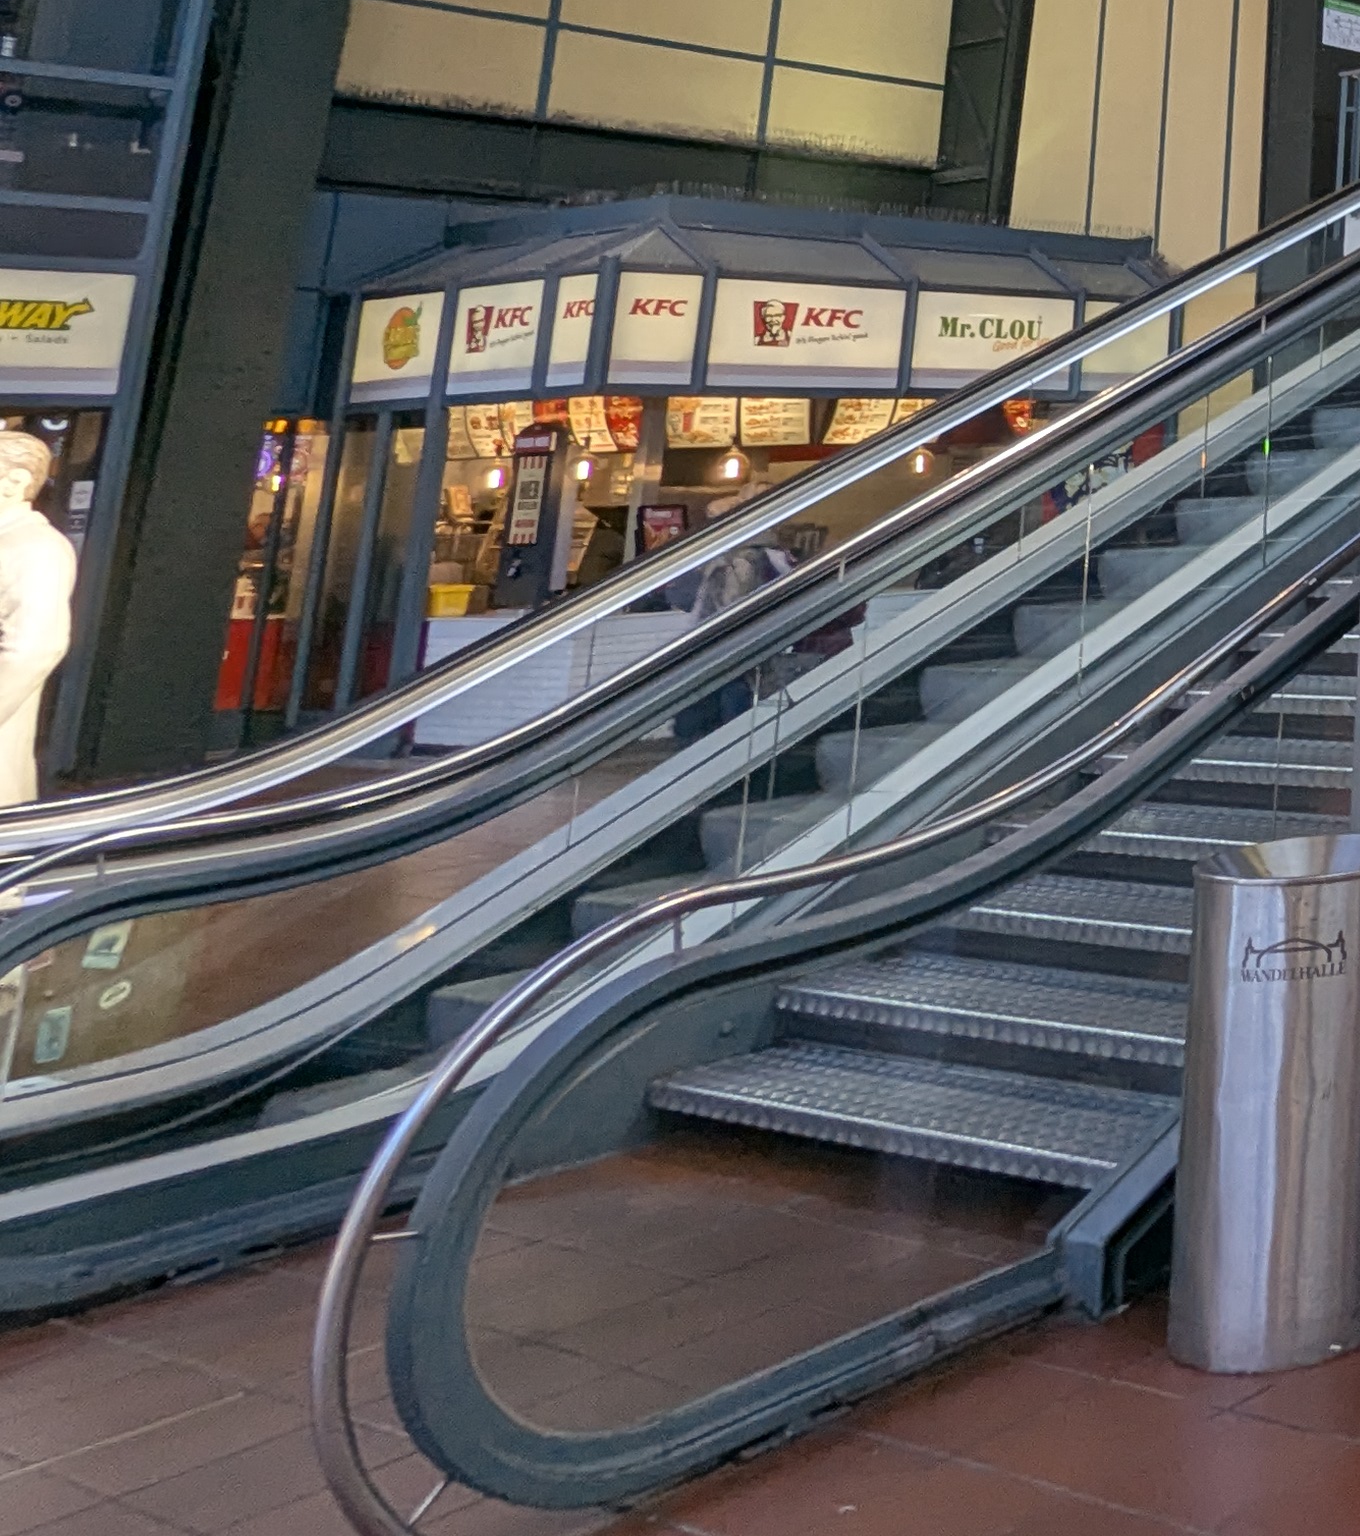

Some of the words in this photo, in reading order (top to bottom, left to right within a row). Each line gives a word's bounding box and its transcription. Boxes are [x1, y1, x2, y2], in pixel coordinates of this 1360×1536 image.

[494, 305, 534, 330] KFC
[562, 299, 597, 320] KFC
[629, 298, 689, 317] KFC
[800, 307, 864, 330] KFC
[938, 316, 976, 338] Mr.
[979, 317, 1043, 340] CLOU
